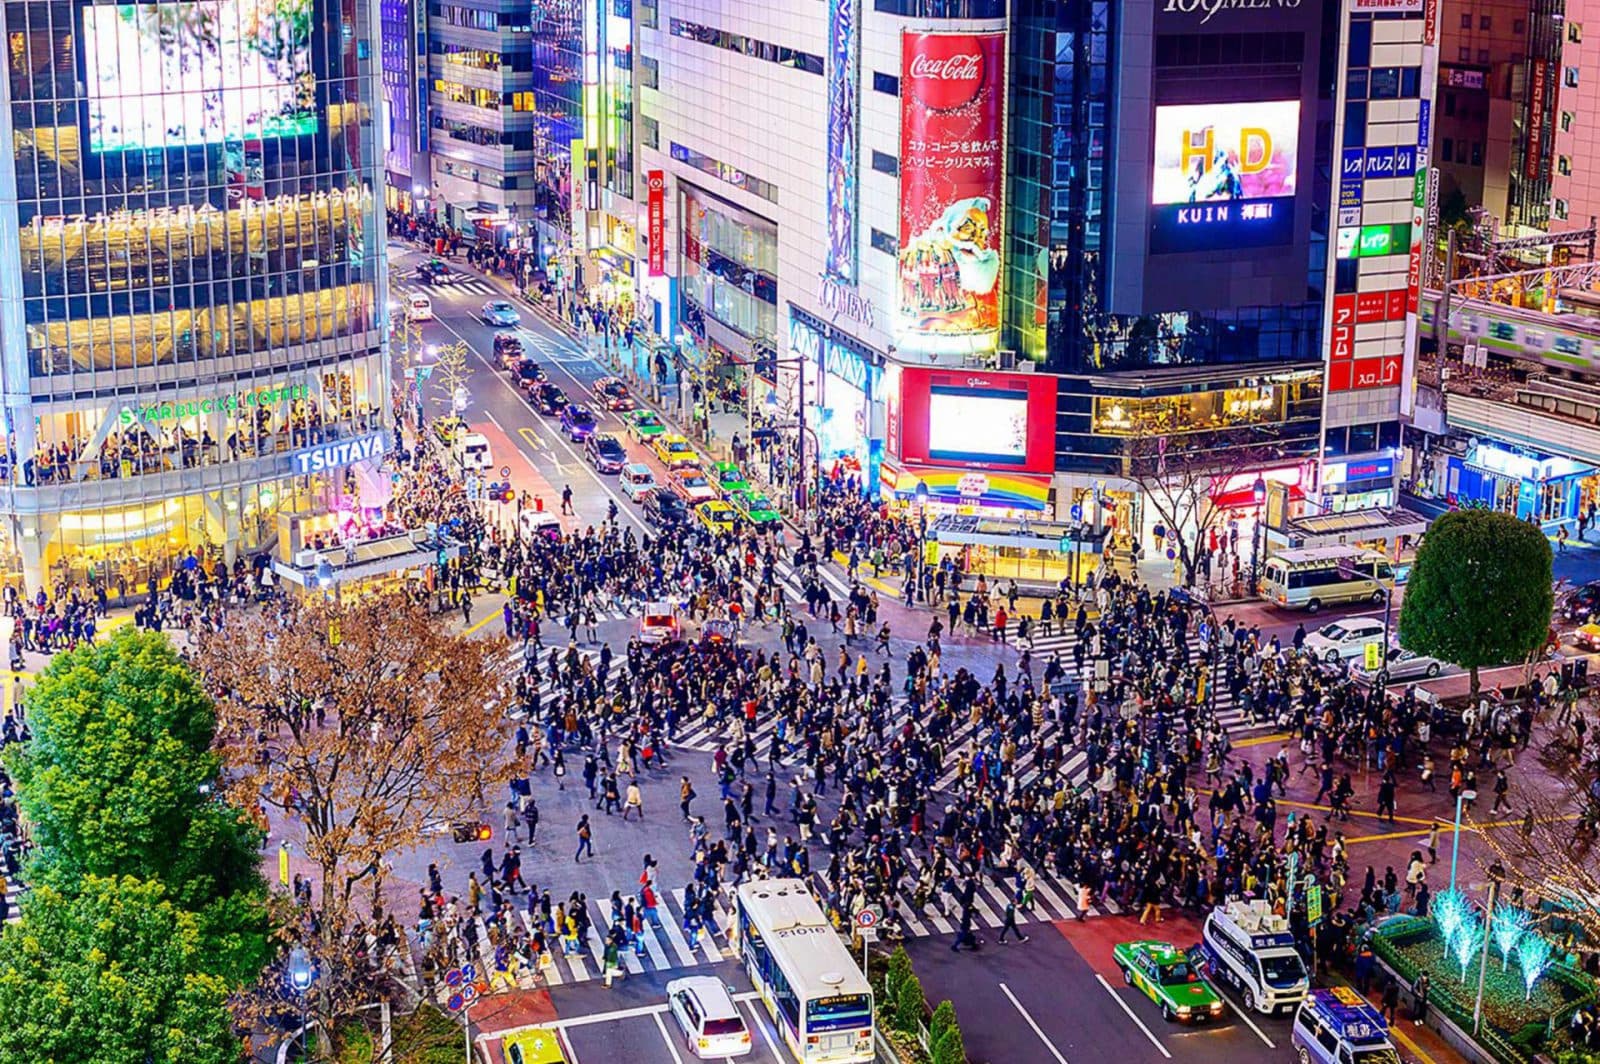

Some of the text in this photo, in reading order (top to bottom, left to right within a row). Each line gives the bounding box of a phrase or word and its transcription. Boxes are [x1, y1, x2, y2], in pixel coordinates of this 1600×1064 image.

[910, 53, 983, 80] Coca-Cola
[1178, 207, 1229, 224] KUIN
[1361, 234, 1389, 249] レイク
[1409, 252, 1420, 286] アコム
[1335, 308, 1350, 356] アコム
[120, 384, 309, 424] STARBUCKS COFFEE
[297, 436, 384, 473] TSUTAYA
[778, 926, 826, 939] 21016
